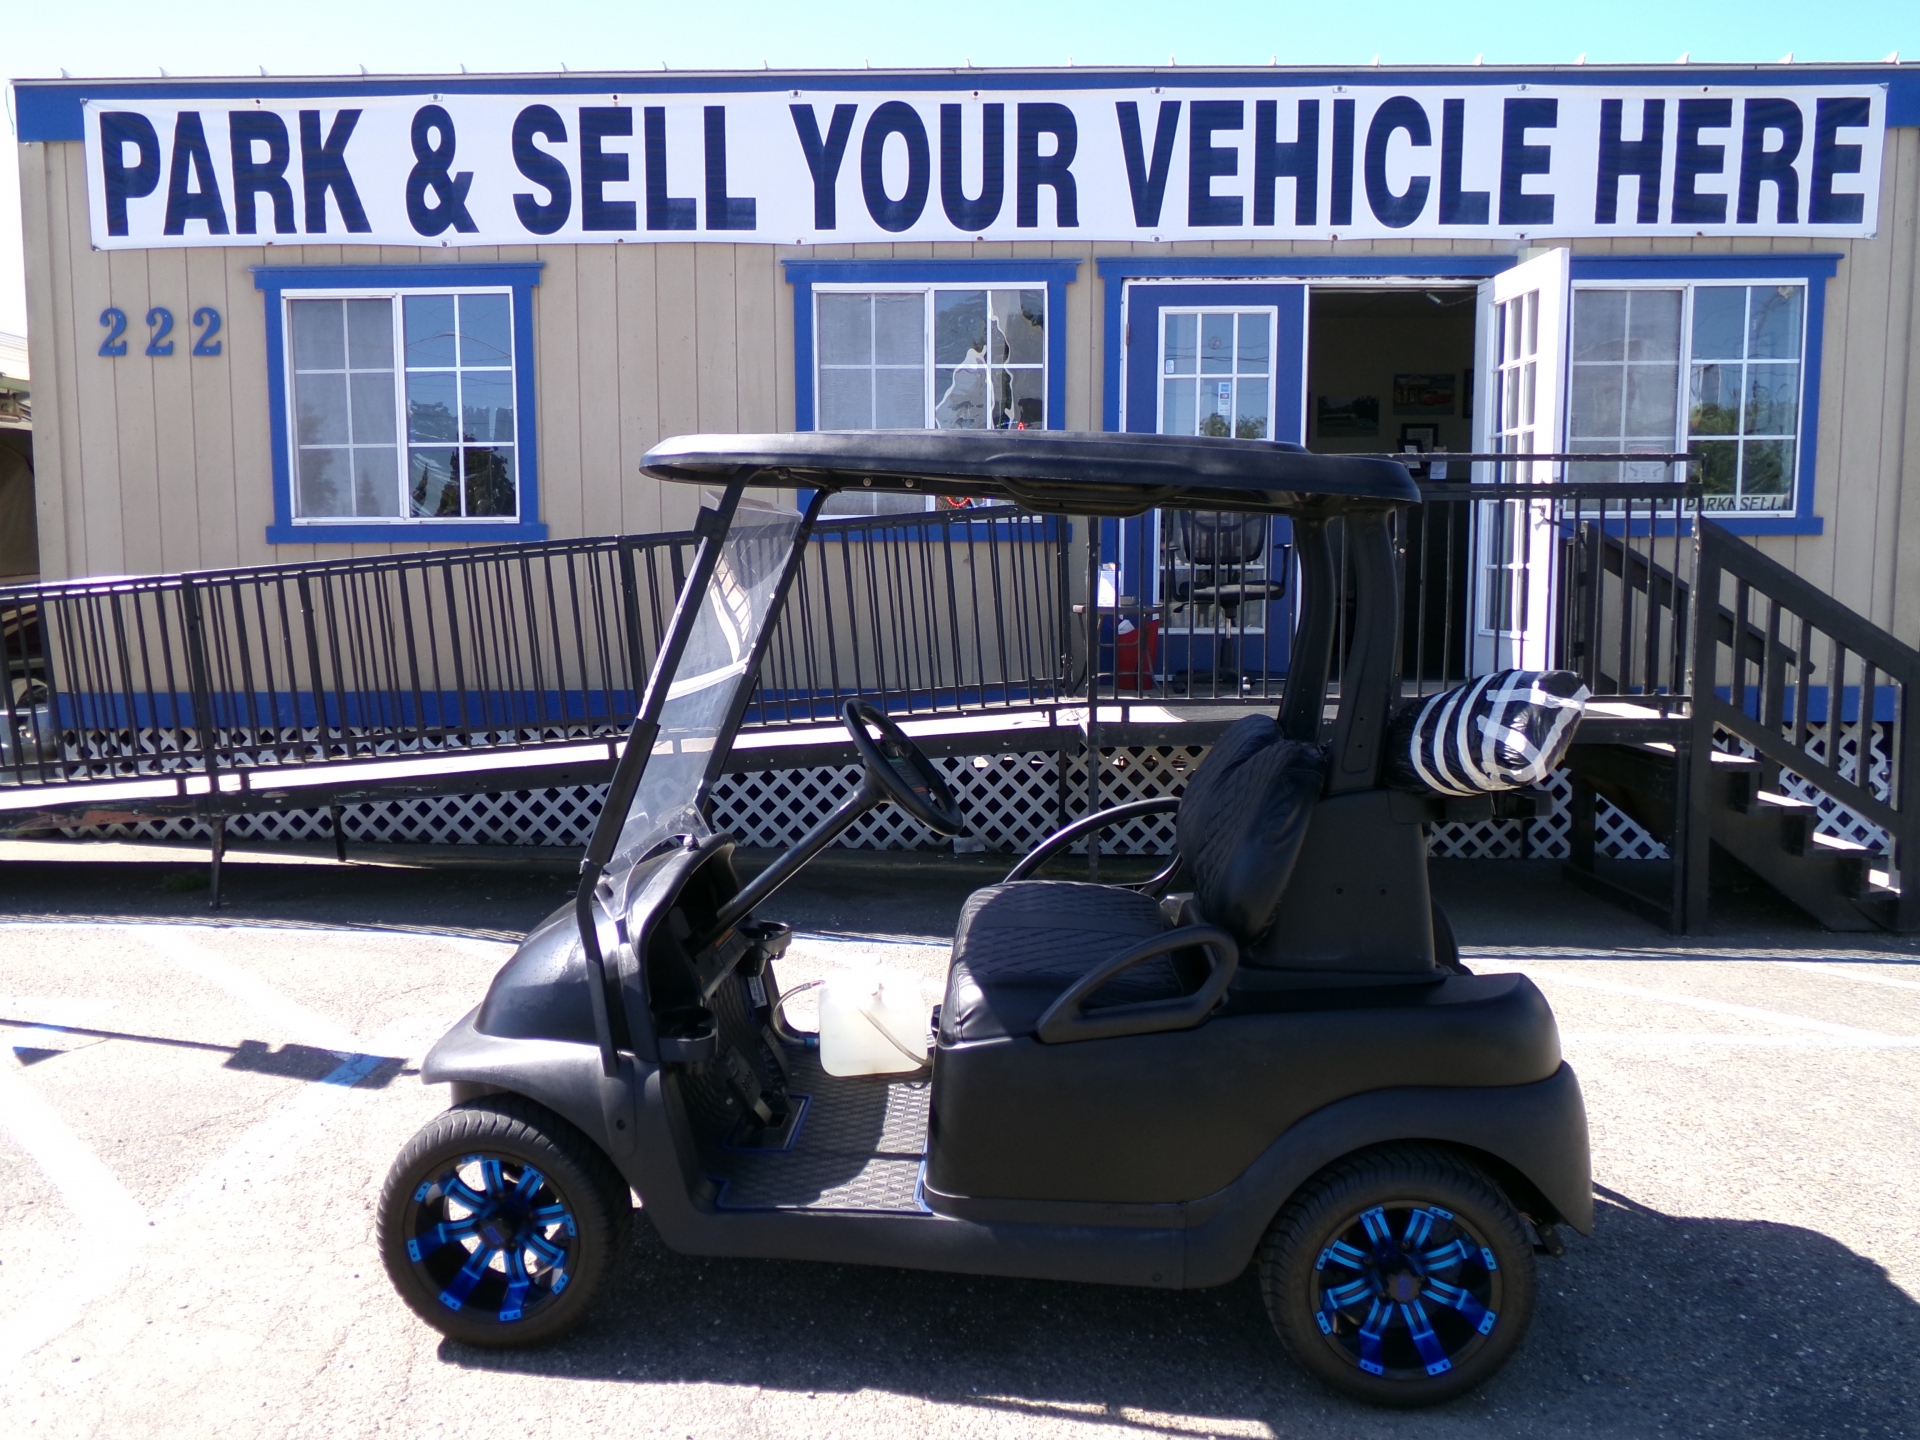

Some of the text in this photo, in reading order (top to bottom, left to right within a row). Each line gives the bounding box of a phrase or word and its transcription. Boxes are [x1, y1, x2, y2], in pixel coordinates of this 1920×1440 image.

[100, 96, 1870, 236] PARK & SELL YOUR VEHICLE HERE
[98, 307, 221, 357] 222
